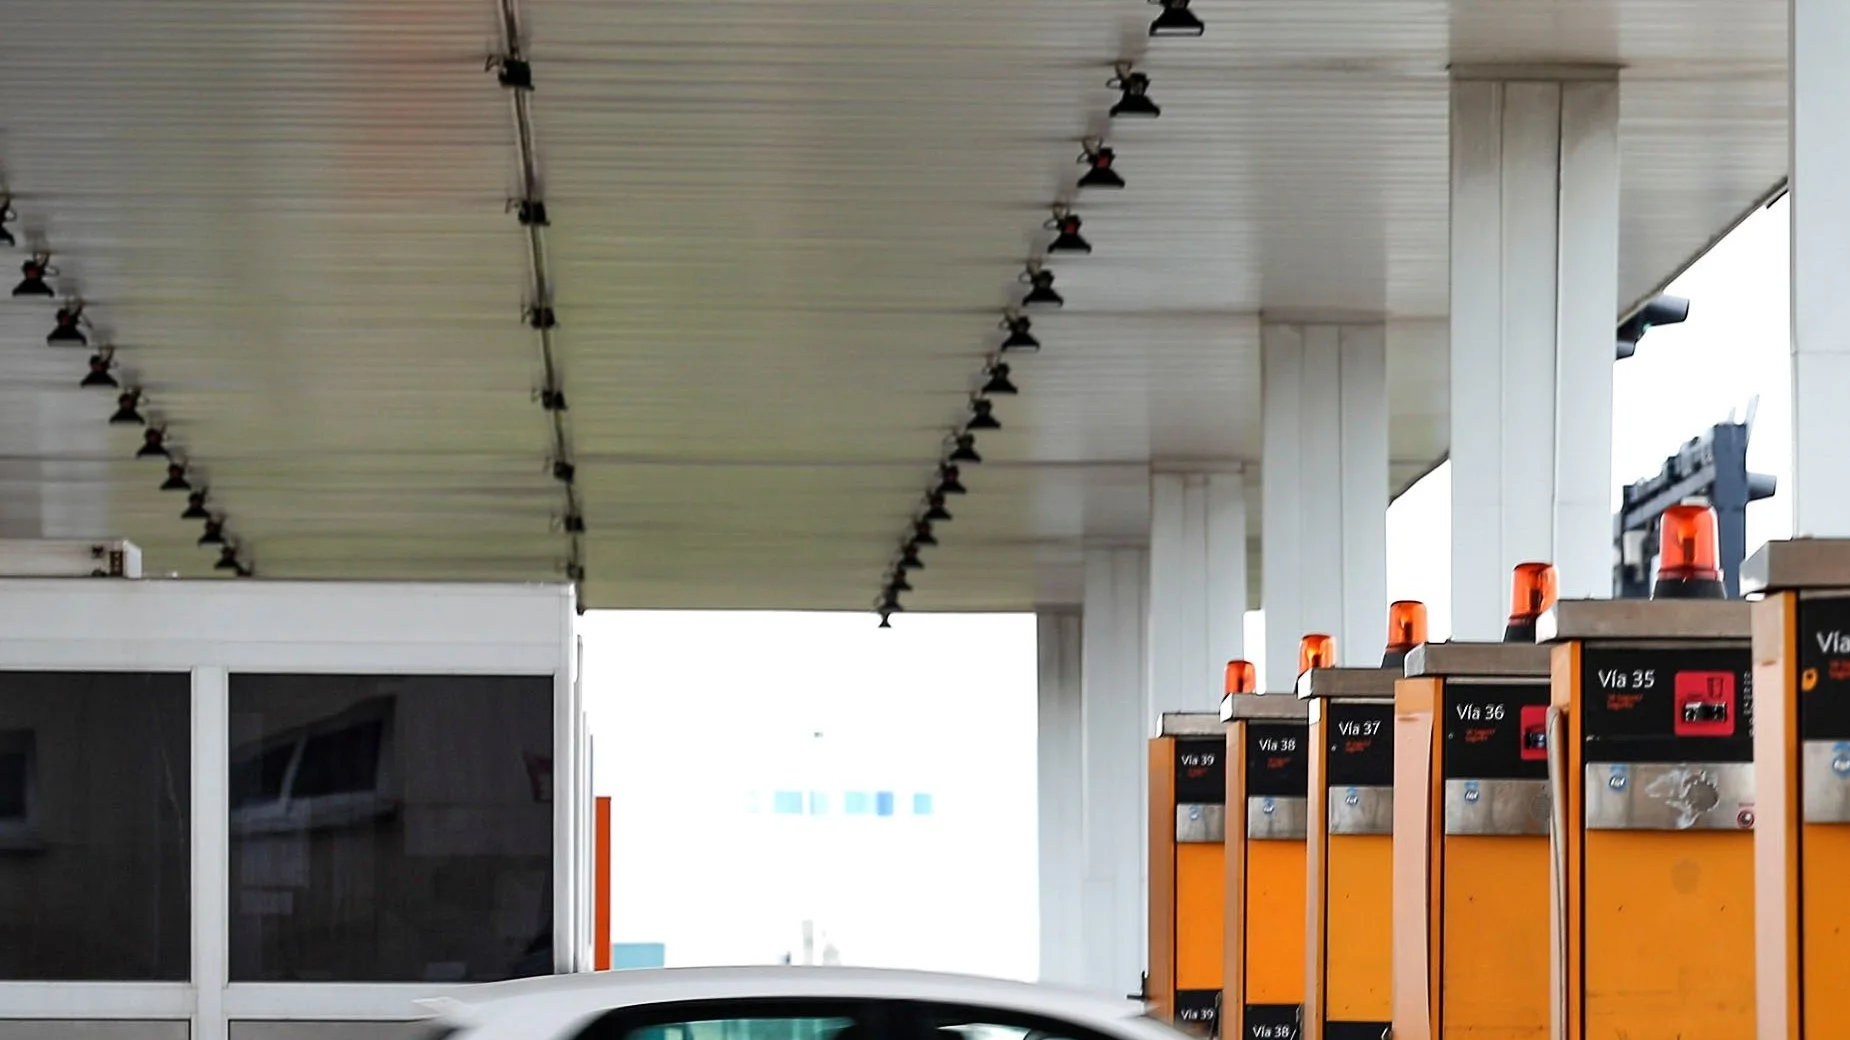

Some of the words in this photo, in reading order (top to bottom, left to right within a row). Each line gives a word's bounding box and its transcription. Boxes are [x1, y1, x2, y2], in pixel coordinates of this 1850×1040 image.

[1598, 669, 1627, 688] Vía
[1632, 669, 1655, 689] 35
[1456, 703, 1481, 720] Vía
[1485, 703, 1505, 720] 36
[1338, 720, 1360, 736] Vía
[1363, 720, 1381, 736] 37
[1280, 738, 1296, 751] 38
[1201, 754, 1215, 766] 39
[1200, 1008, 1214, 1020] 39
[1274, 1025, 1290, 1038] 38
